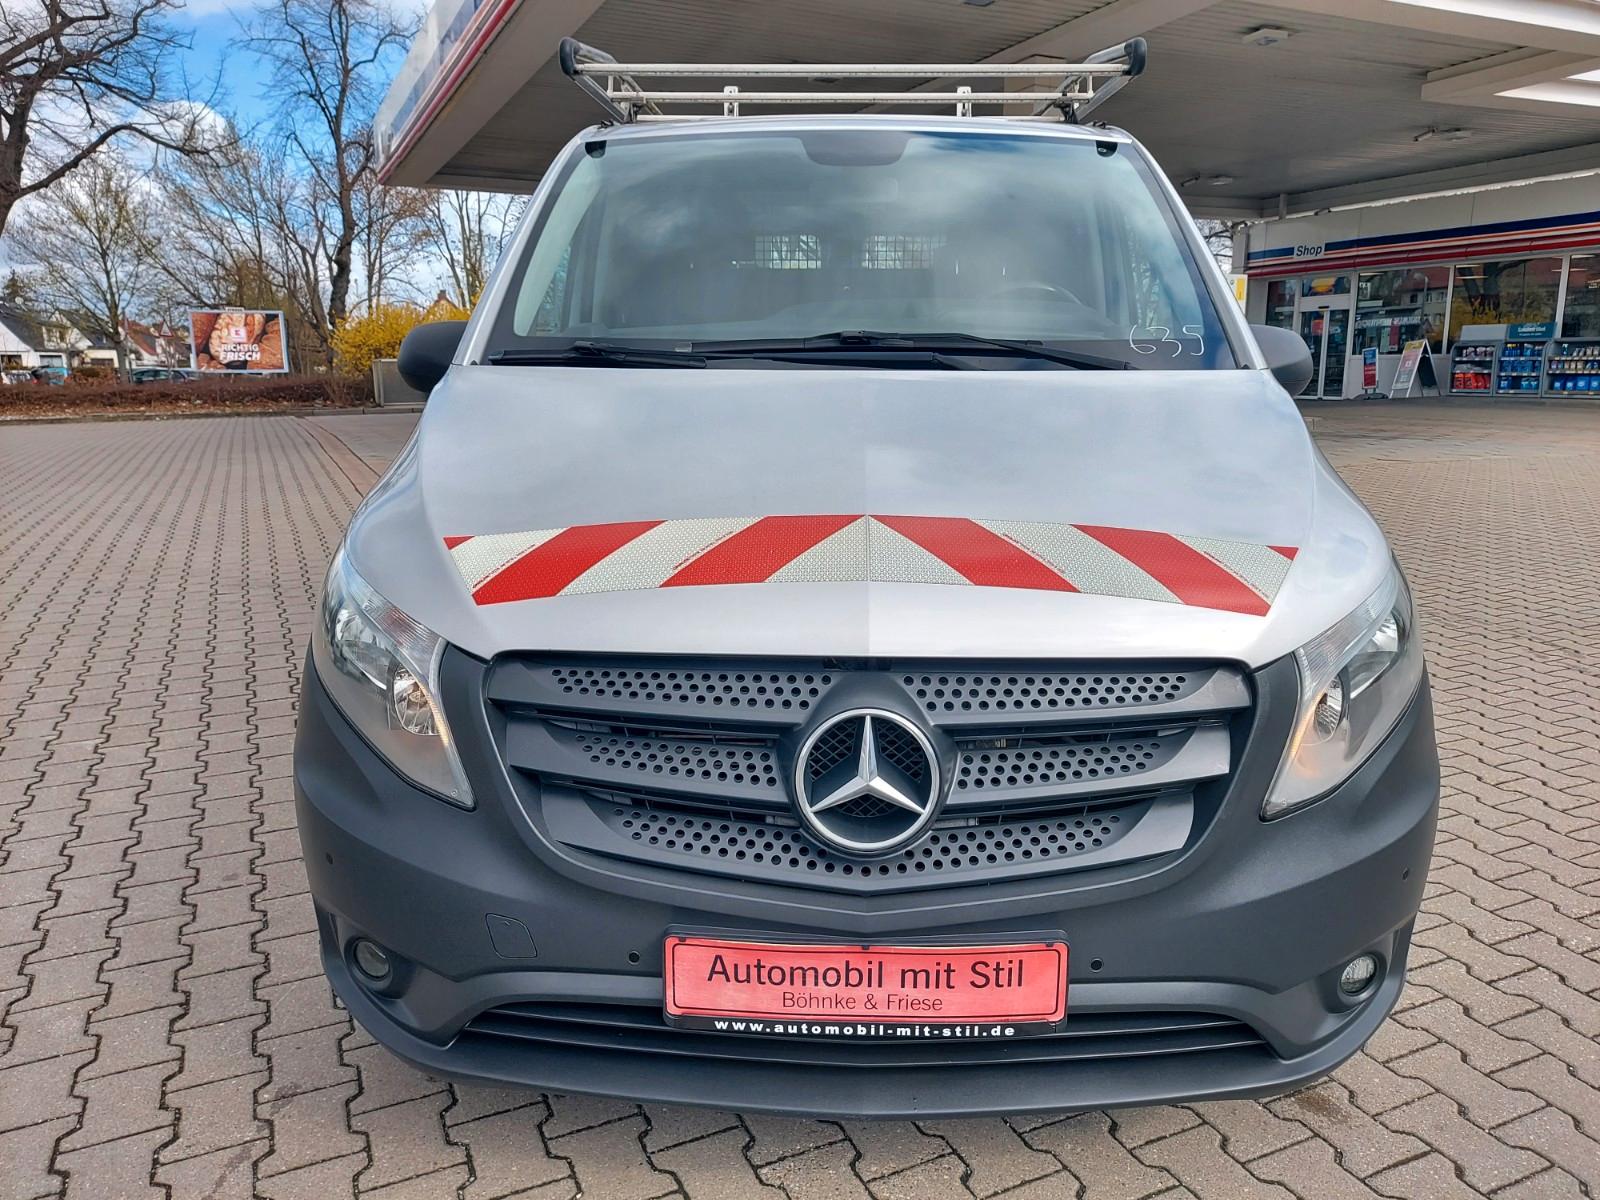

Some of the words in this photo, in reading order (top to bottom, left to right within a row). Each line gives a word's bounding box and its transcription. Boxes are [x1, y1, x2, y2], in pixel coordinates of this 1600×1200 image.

[1296, 244, 1323, 257] Shop
[221, 343, 259, 352] RICHTIG
[220, 352, 261, 361] FRISCH
[707, 954, 884, 988] Automobil
[900, 961, 956, 990] mit
[969, 959, 1024, 989] Stil
[782, 991, 857, 1010] Böhnke
[863, 993, 879, 1010] &
[887, 993, 944, 1011] Friese
[713, 1019, 1016, 1037] www.automobil-mit-stil.de
